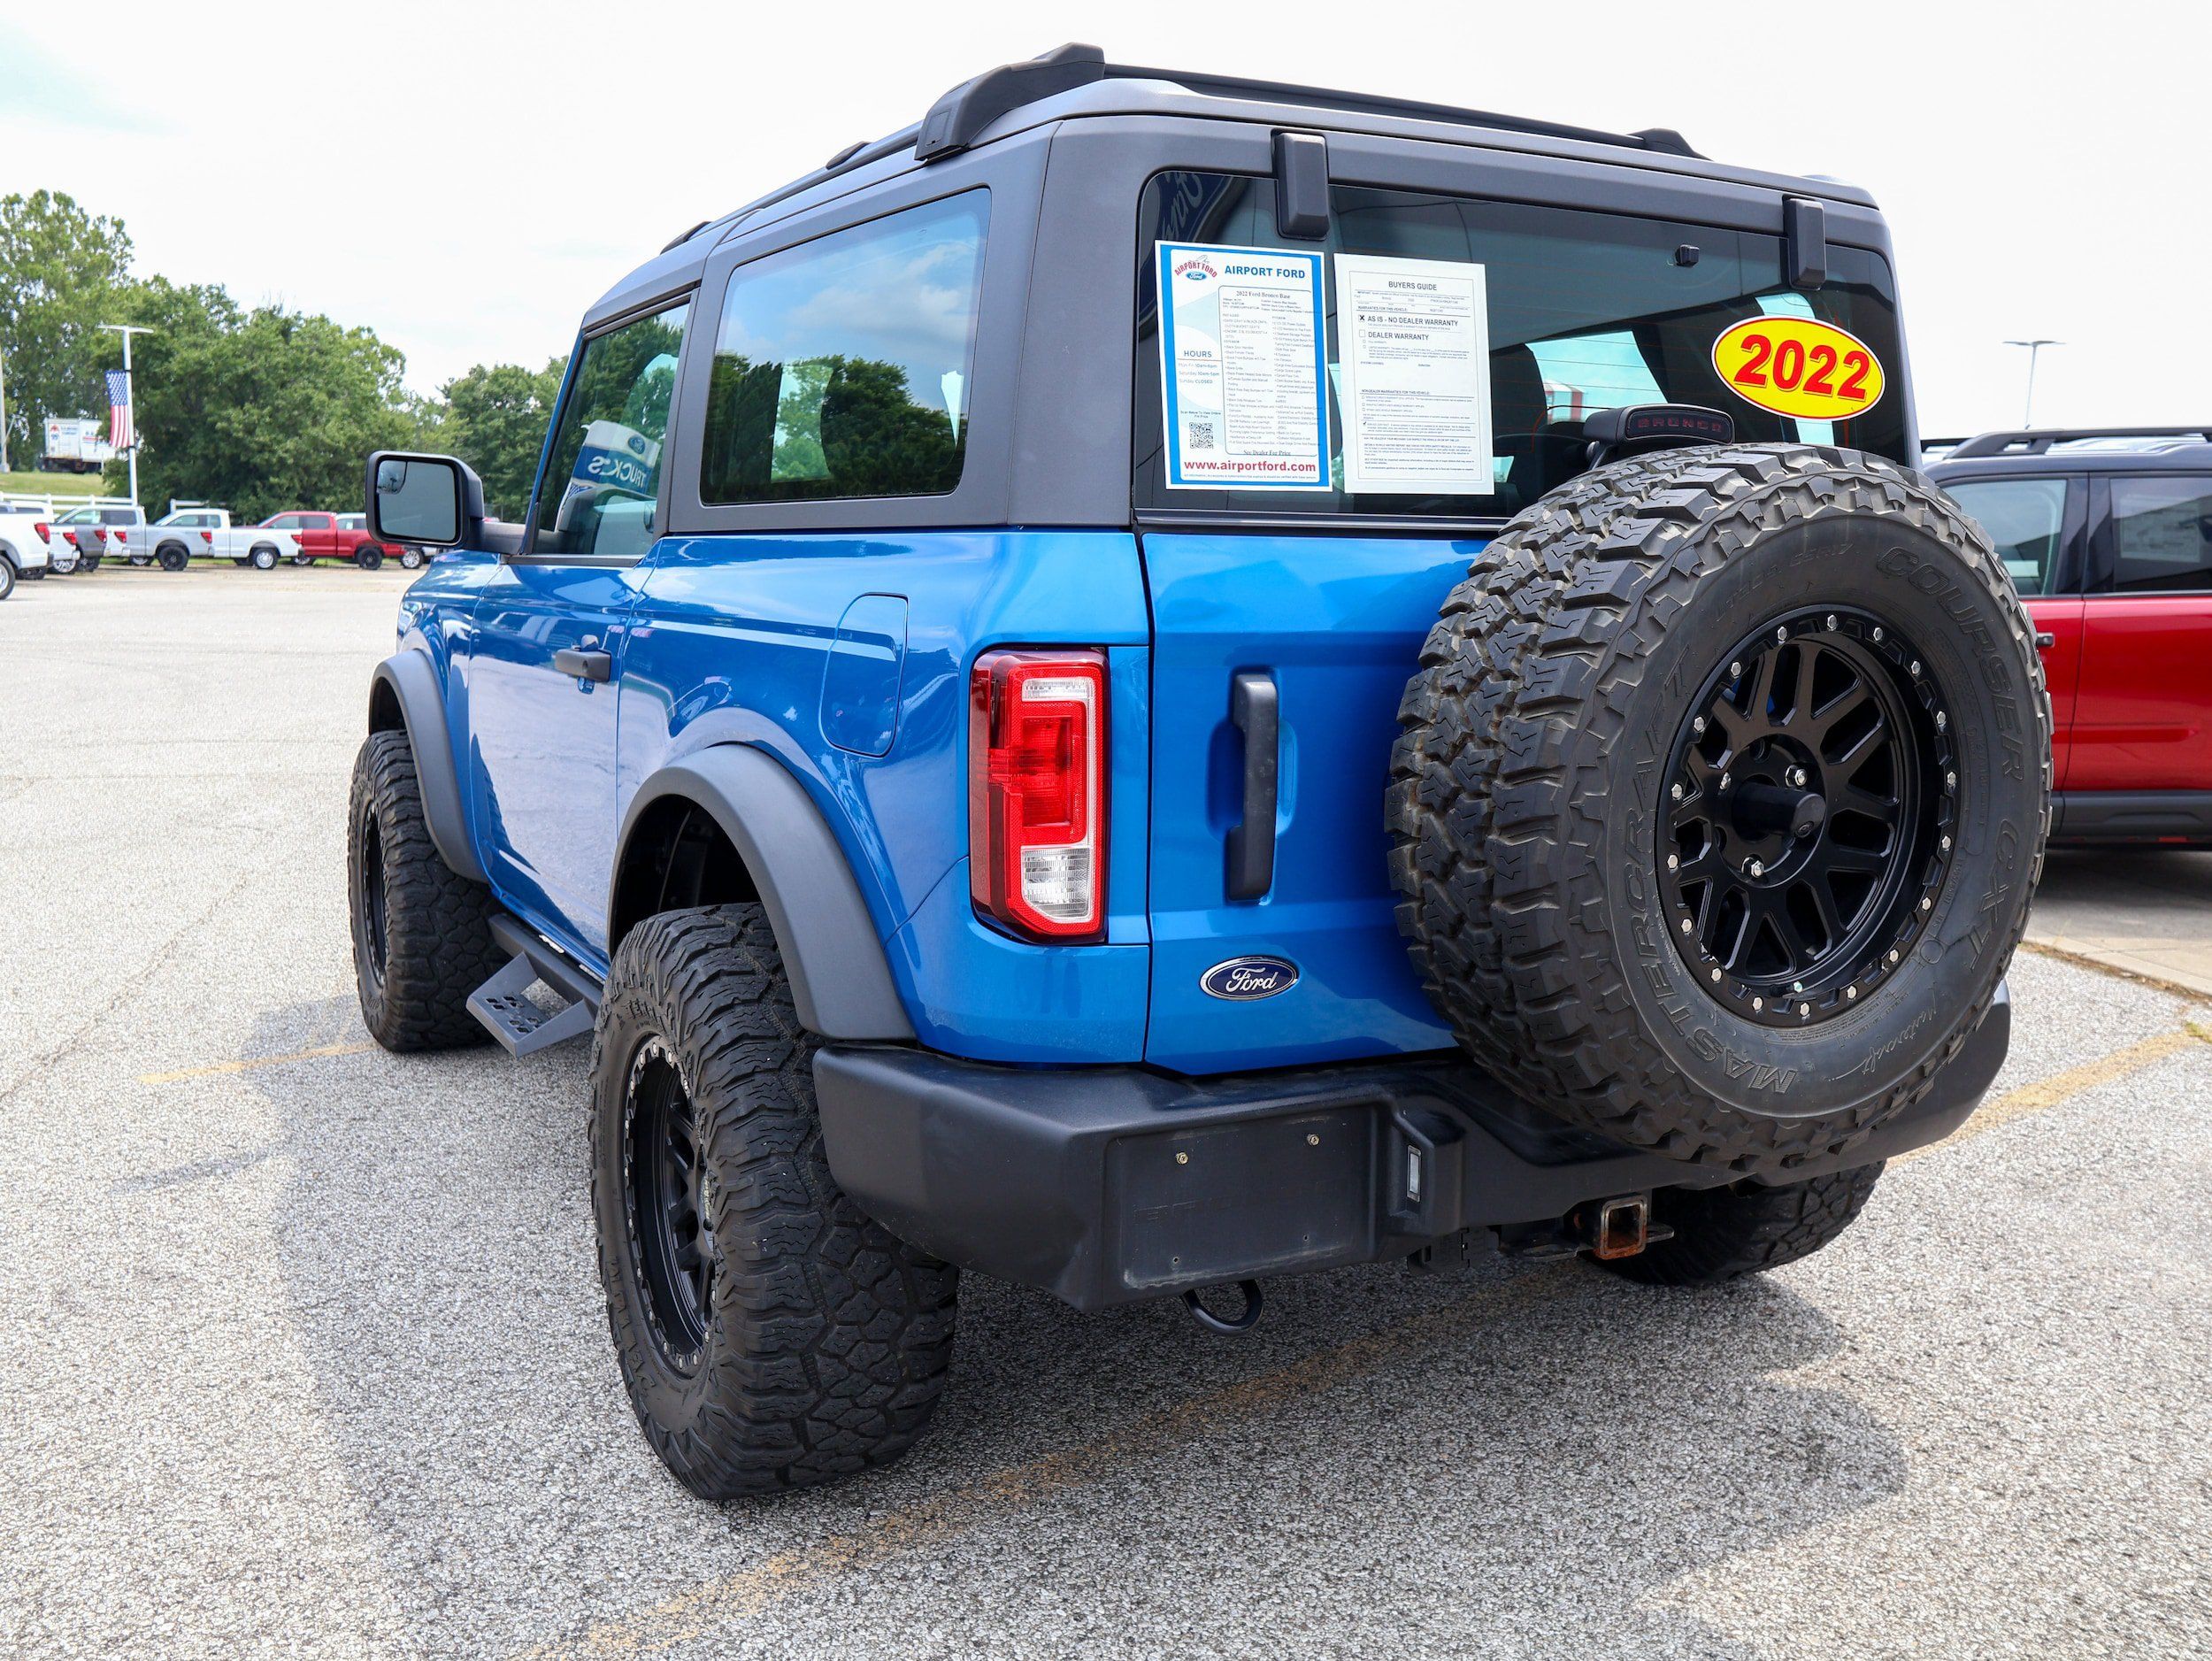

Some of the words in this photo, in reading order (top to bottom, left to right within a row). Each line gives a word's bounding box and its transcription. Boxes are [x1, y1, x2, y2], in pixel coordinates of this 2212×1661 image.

[1174, 260, 1201, 275] AIRPORT
[1201, 263, 1217, 278] FORD
[1225, 265, 1273, 277] AIRPORT
[1276, 268, 1306, 279] FORD
[1388, 281, 1416, 289] BUYERS
[1417, 282, 1438, 291] GUIDE
[1394, 332, 1430, 341] WARRANTY
[1733, 334, 1870, 403] 2022
[1638, 417, 1722, 433] BRONCO
[1184, 459, 1317, 473] www.airportford.com
[1876, 545, 2025, 781] COURSER
[1968, 819, 2019, 973] CXT
[1624, 643, 1798, 1096] MASTERCRAFT
[1225, 966, 1279, 993] Ford
